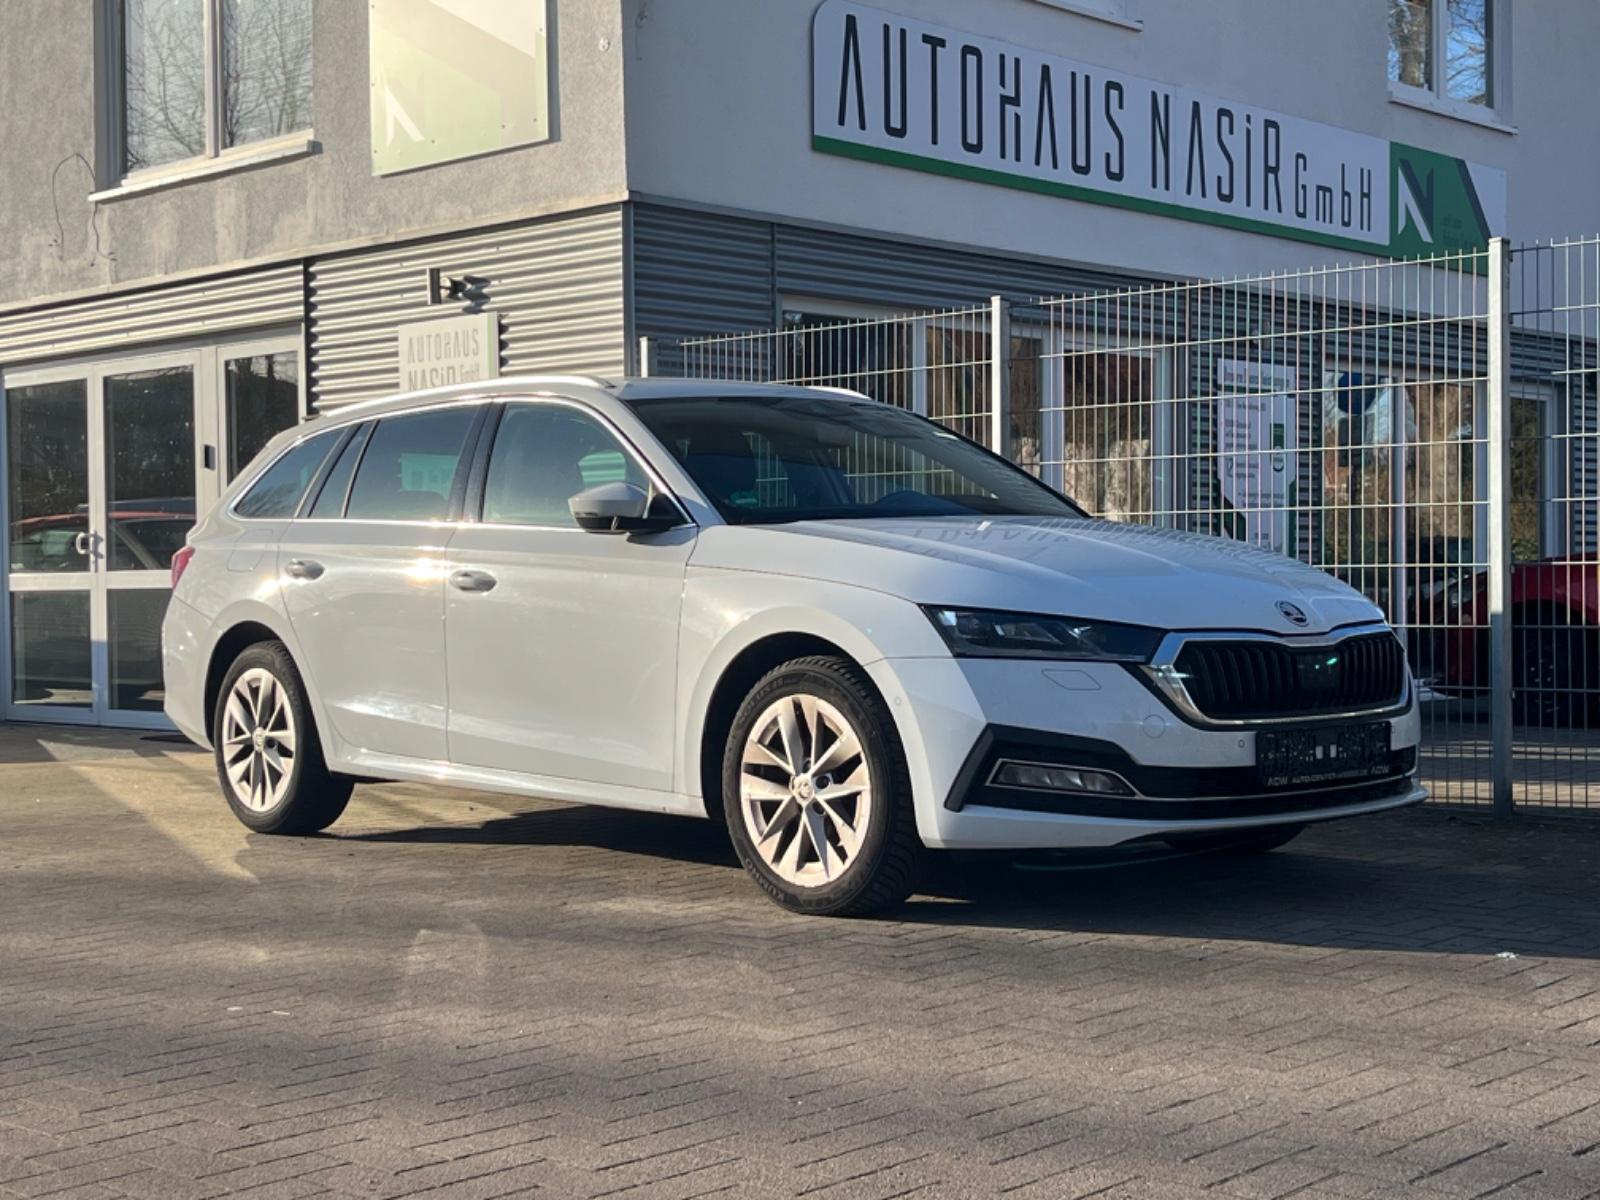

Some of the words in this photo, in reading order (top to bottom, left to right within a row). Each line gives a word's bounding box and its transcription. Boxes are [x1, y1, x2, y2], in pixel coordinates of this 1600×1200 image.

[838, 14, 1124, 182] AUTOHAUS
[1294, 152, 1371, 232] GmbH
[408, 328, 479, 363] AUTOHAUS
